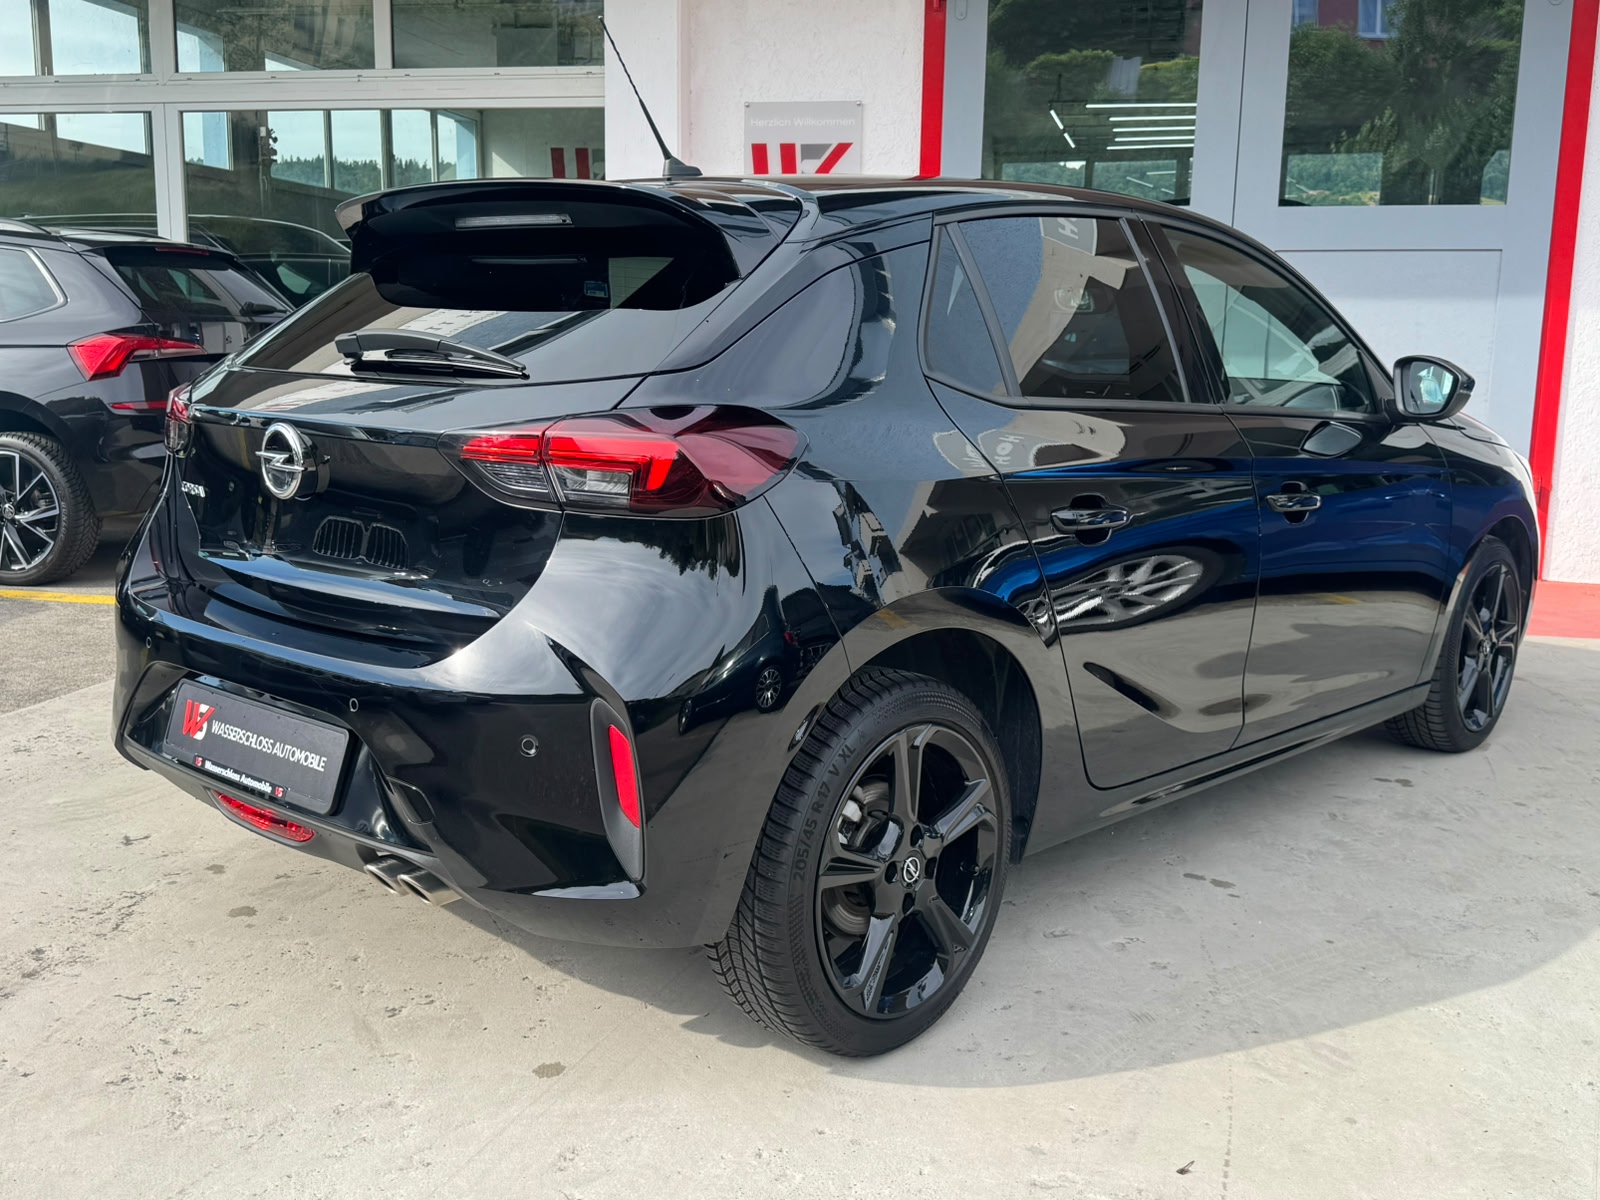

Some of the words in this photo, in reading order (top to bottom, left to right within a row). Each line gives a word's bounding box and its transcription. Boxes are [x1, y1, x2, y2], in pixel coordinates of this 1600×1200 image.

[750, 118, 791, 128] Herzlich
[793, 117, 856, 127] Willkommen
[211, 719, 274, 753] WASSERSCHLOSS
[272, 742, 327, 772] AUTOMOBILE
[204, 759, 241, 781] Wasserschloss
[239, 773, 272, 794] Automobile
[793, 818, 818, 881] 205/45
[828, 763, 840, 777] V
[838, 744, 857, 763] XL
